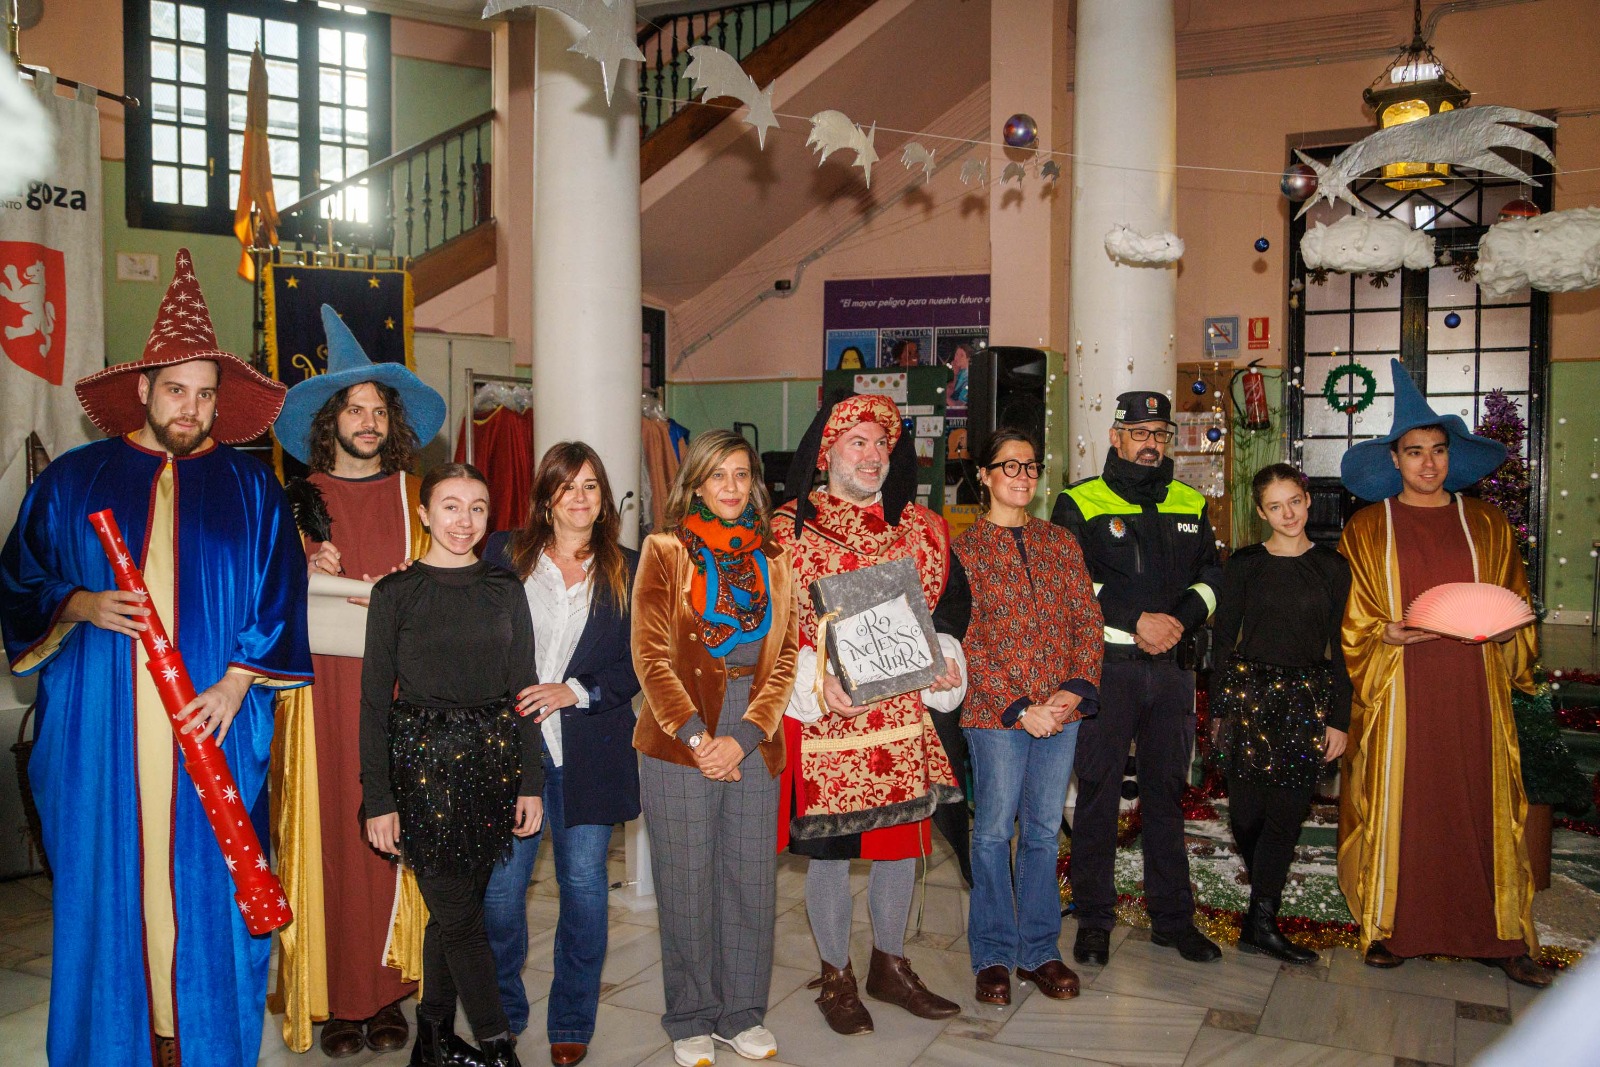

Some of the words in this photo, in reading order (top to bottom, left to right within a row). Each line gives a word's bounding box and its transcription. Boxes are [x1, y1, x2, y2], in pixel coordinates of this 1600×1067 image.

[26, 180, 87, 211] goza
[0, 200, 22, 210] NTO
[852, 300, 876, 309] mayor
[878, 297, 906, 309] peligro
[907, 299, 927, 307] para
[928, 297, 957, 305] nuestro
[959, 294, 983, 304] futuro
[950, 506, 978, 515] BUZO
[1177, 522, 1199, 533] POLIC
